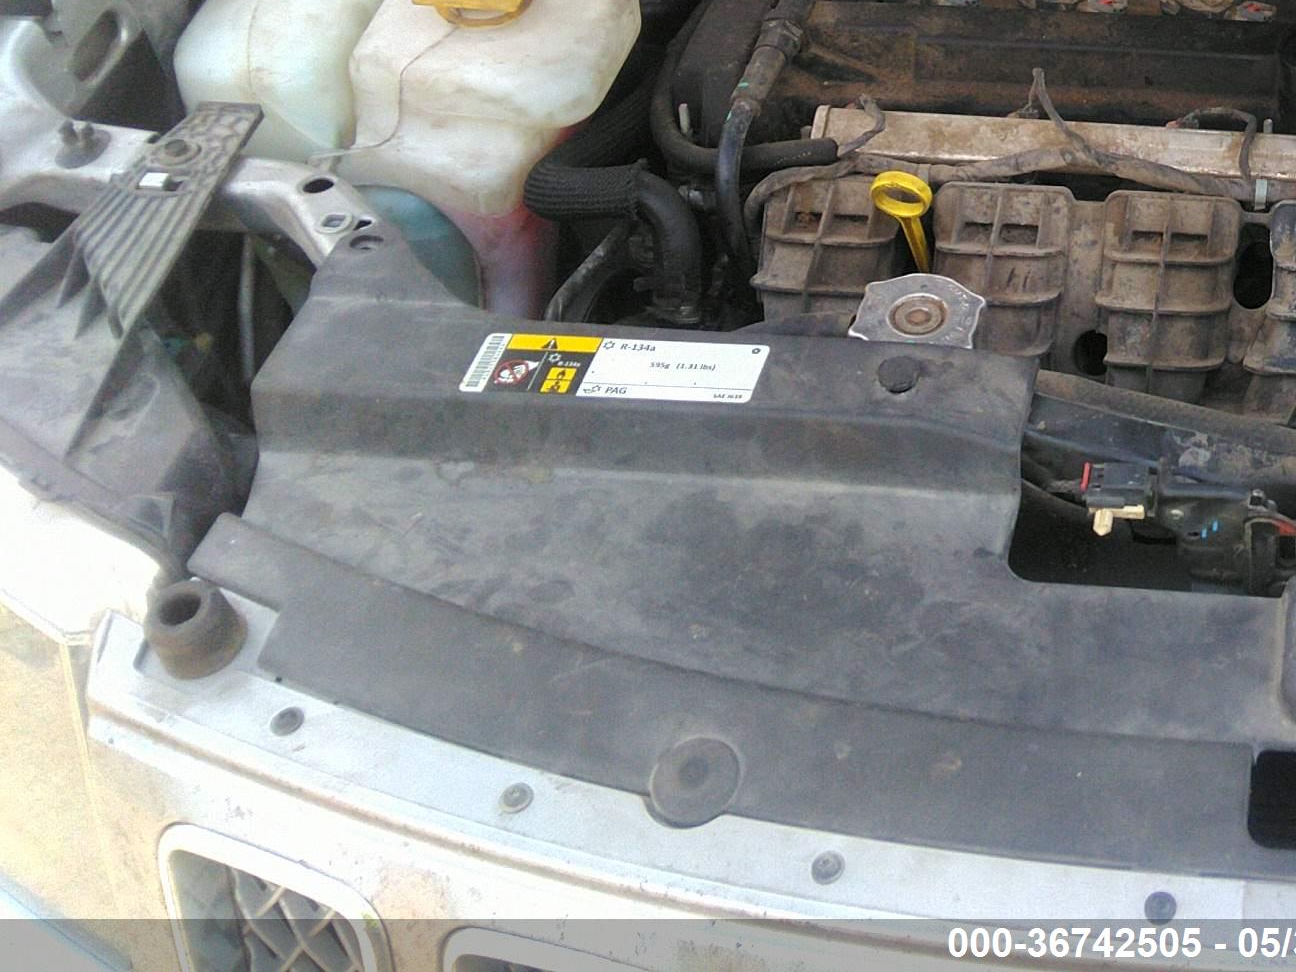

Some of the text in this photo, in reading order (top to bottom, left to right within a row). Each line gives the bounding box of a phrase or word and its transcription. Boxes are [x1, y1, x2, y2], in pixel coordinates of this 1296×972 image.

[619, 342, 657, 353] R-134a
[649, 361, 671, 370] 595g
[675, 362, 698, 370] (1.31
[604, 385, 627, 395] PAG
